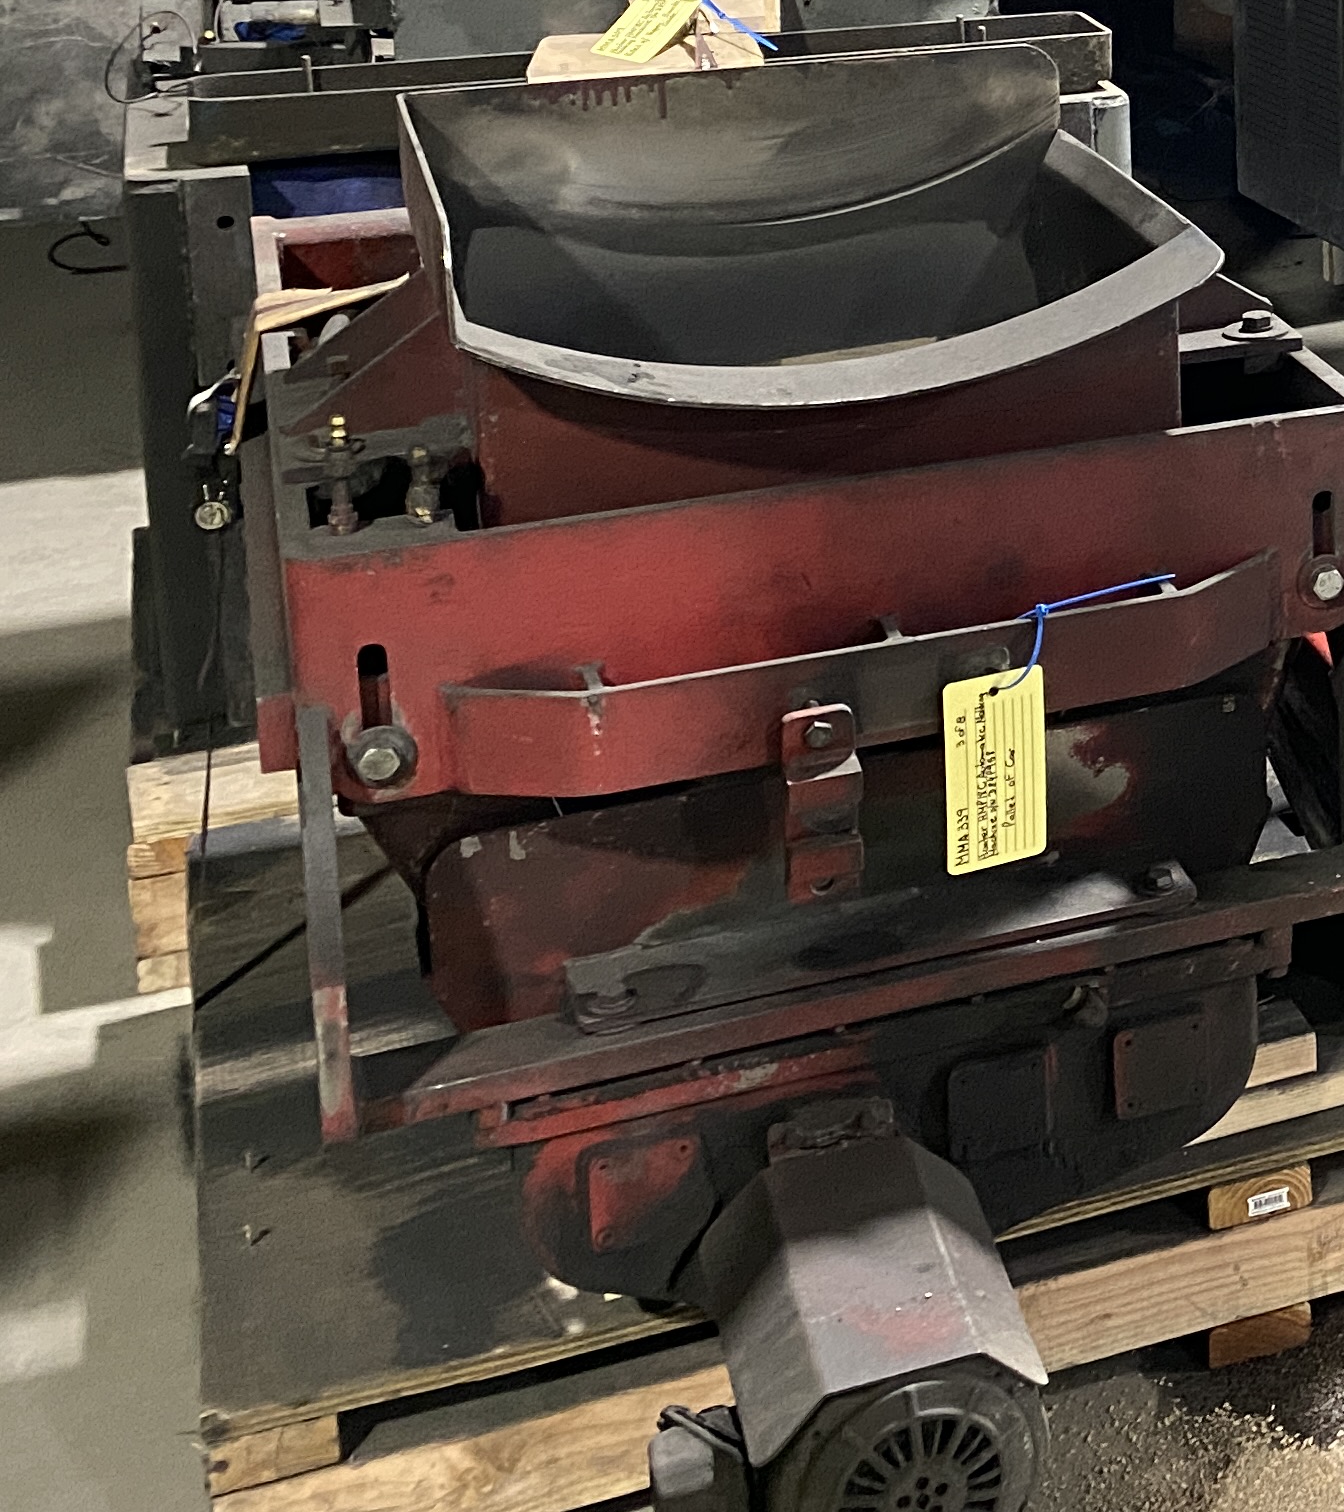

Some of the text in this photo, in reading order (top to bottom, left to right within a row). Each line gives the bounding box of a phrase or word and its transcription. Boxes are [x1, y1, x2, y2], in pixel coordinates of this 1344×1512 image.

[955, 727, 965, 737] of
[1004, 774, 1015, 787] of
[1001, 796, 1016, 828] Pallet
[977, 826, 988, 860] Hunter
